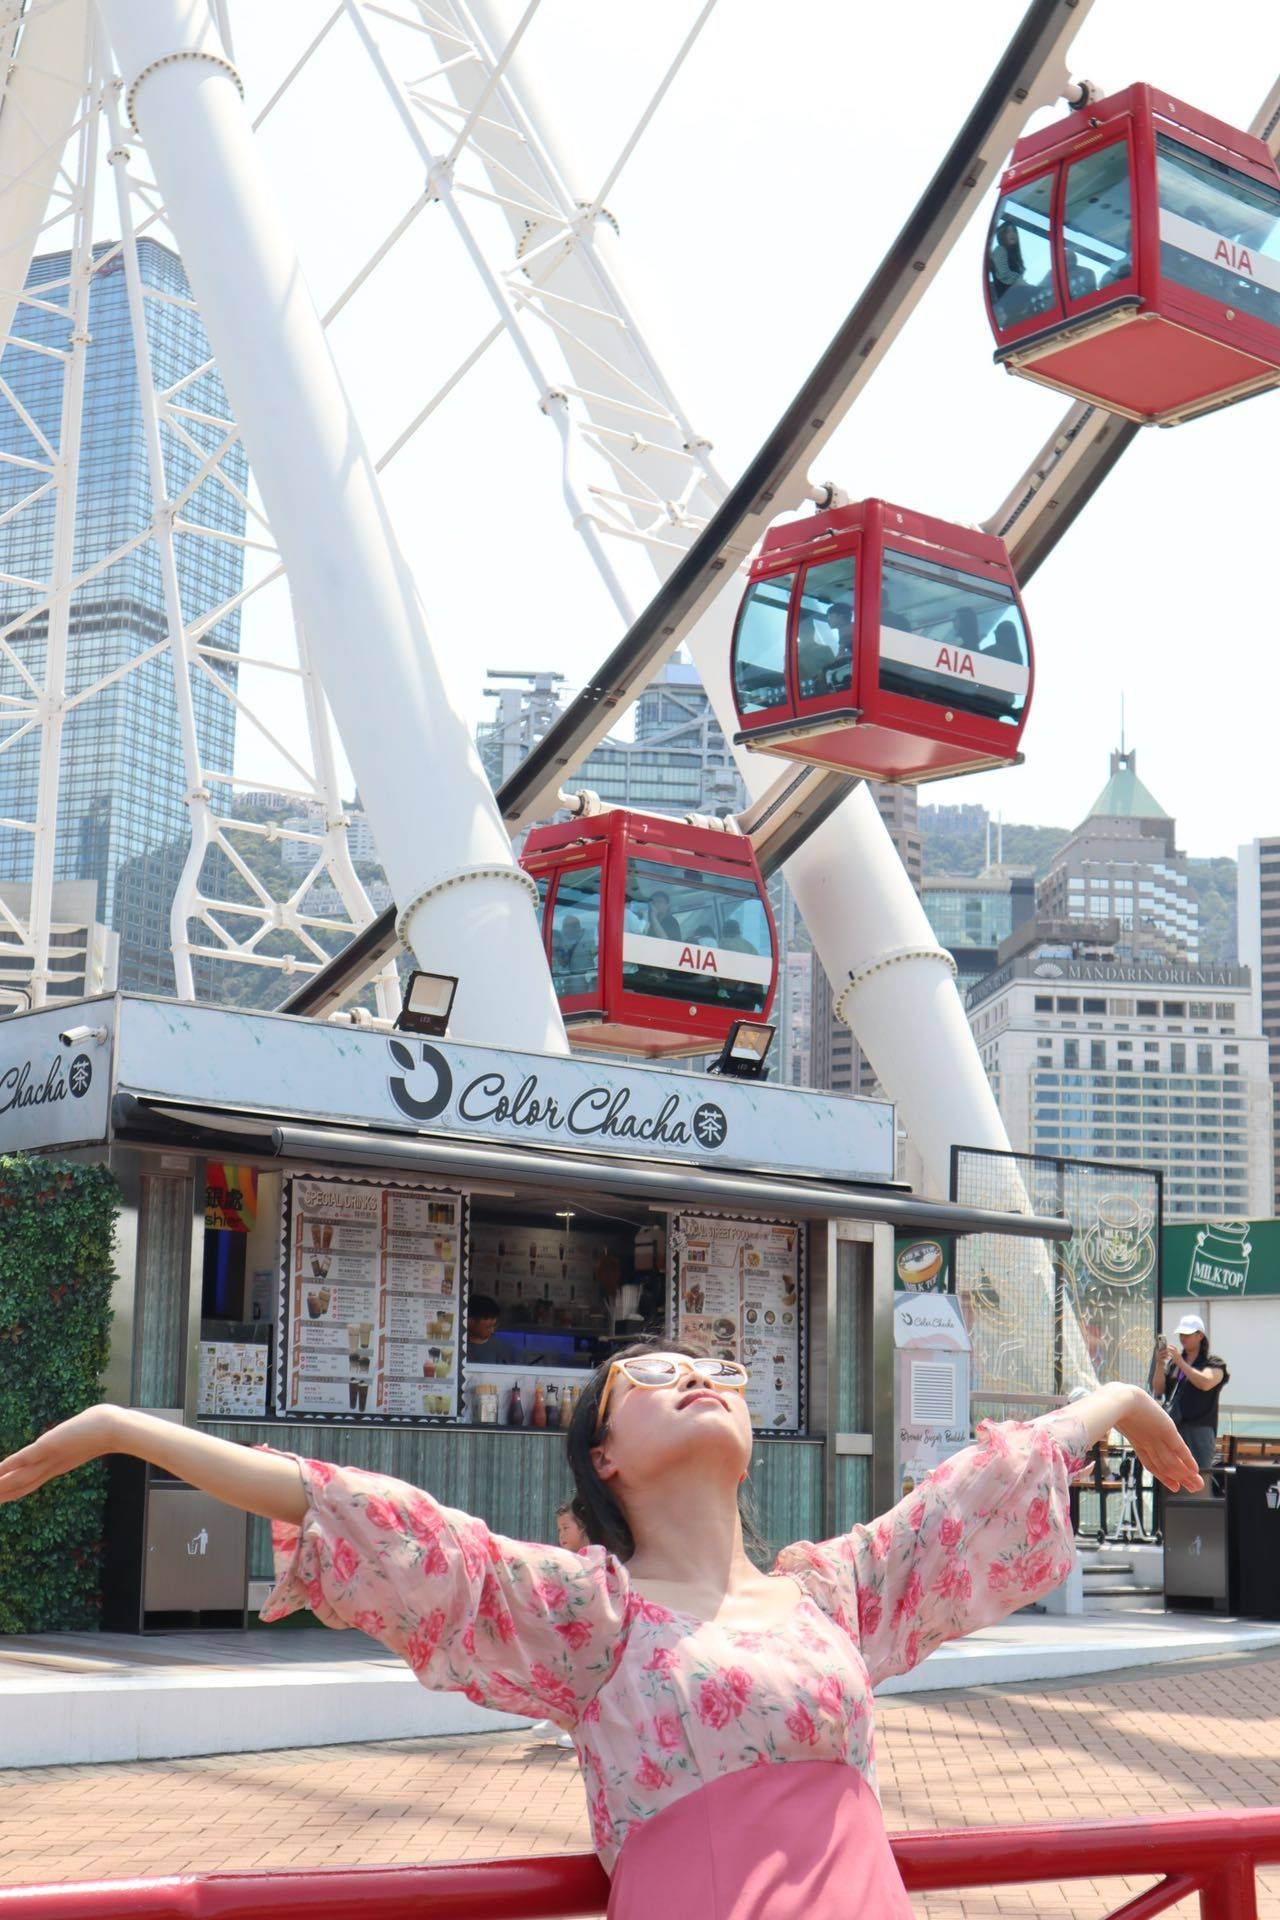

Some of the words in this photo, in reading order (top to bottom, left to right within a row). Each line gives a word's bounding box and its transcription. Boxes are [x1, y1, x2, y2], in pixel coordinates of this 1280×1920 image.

[1168, 102, 1176, 113] 9
[1214, 239, 1253, 276] AIA
[896, 513, 904, 524] 8
[935, 647, 975, 678] AIA
[642, 824, 648, 833] 7
[678, 947, 718, 973] AIA
[1069, 966, 1154, 981] MANDARIN
[1158, 969, 1233, 985] ORIENTAL
[0, 1054, 68, 1114] Chacha
[71, 1060, 90, 1092] 茶
[459, 1073, 565, 1128] Color
[567, 1087, 691, 1144] Chacha
[699, 1109, 723, 1143] 茶
[304, 1190, 343, 1207] SPECIAL
[344, 1192, 377, 1211] DRINKS
[923, 1429, 943, 1447] Sugar
